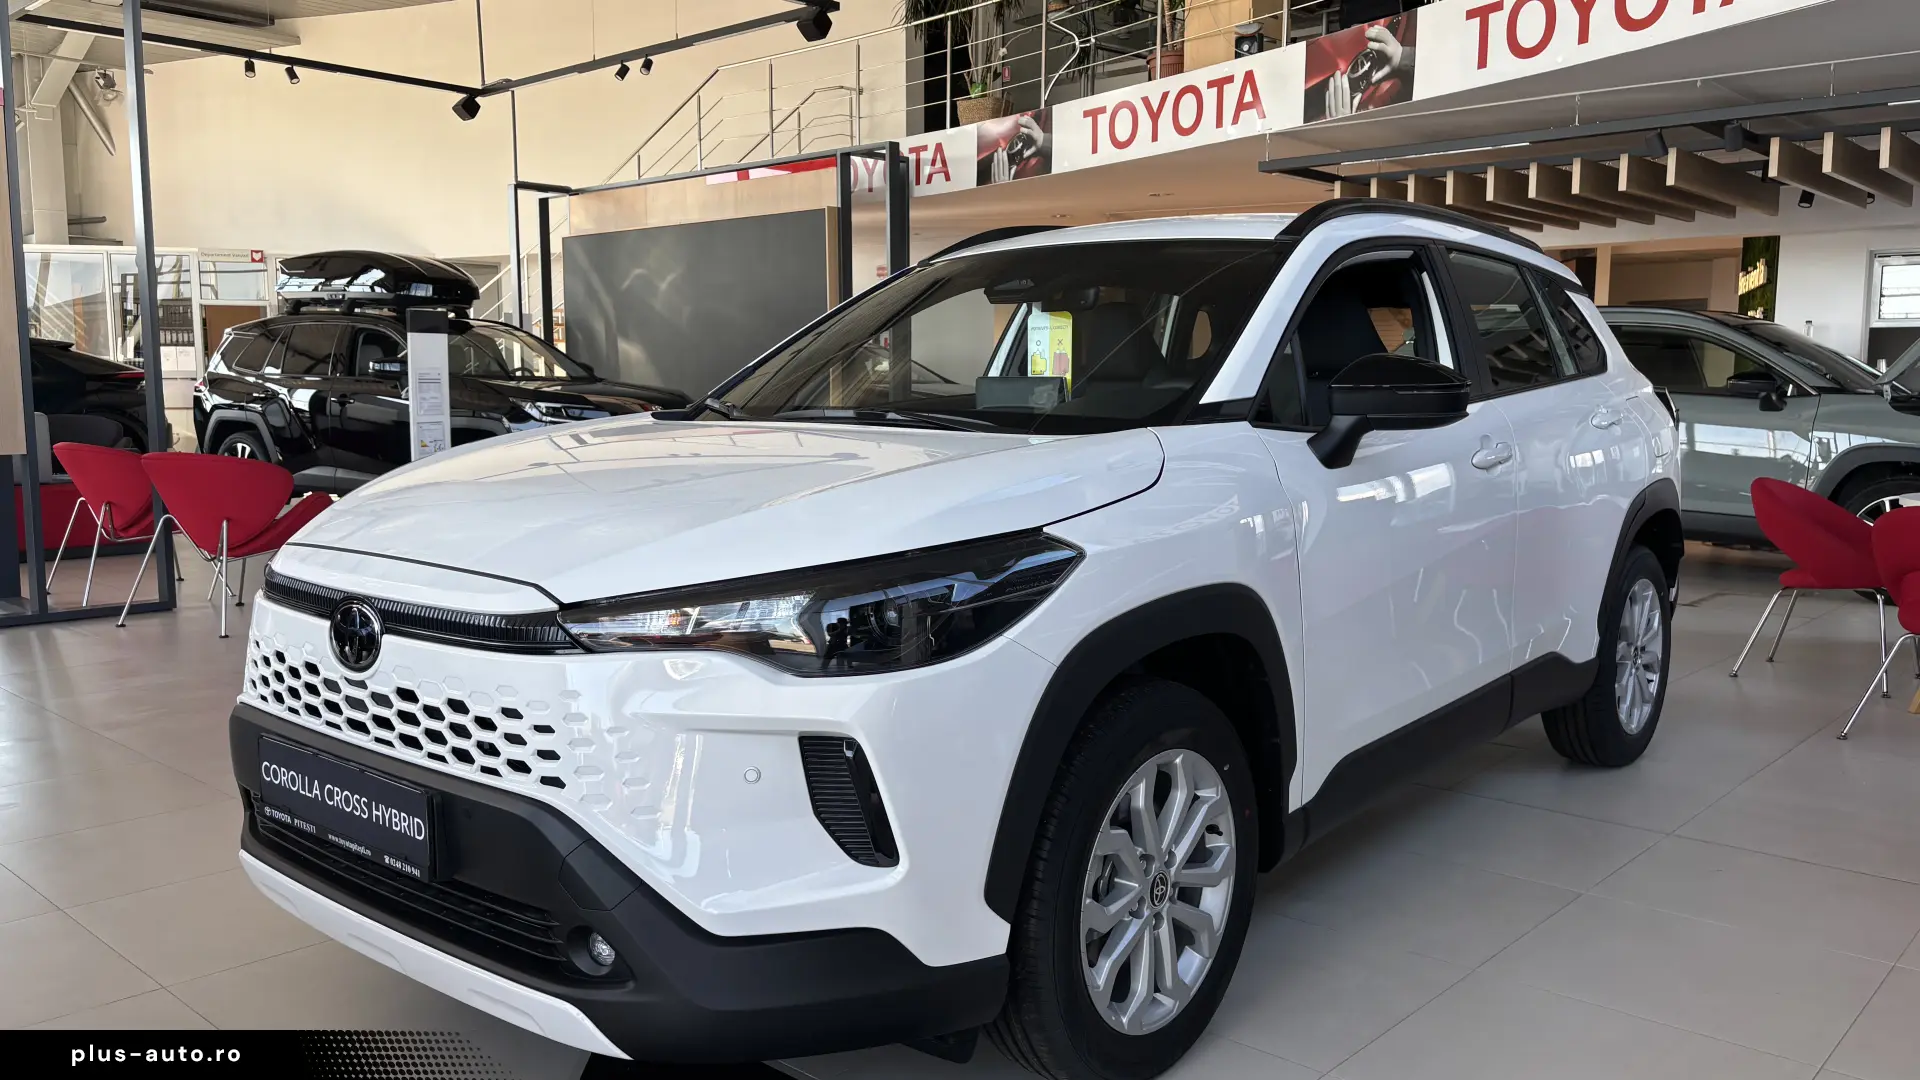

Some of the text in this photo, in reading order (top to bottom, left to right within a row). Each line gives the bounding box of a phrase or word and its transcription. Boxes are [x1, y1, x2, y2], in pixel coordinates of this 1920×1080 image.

[1083, 69, 1266, 155] TOYOTA
[261, 761, 425, 841] COROLLA CROSS HYBRID
[271, 809, 292, 824] TOYOTA
